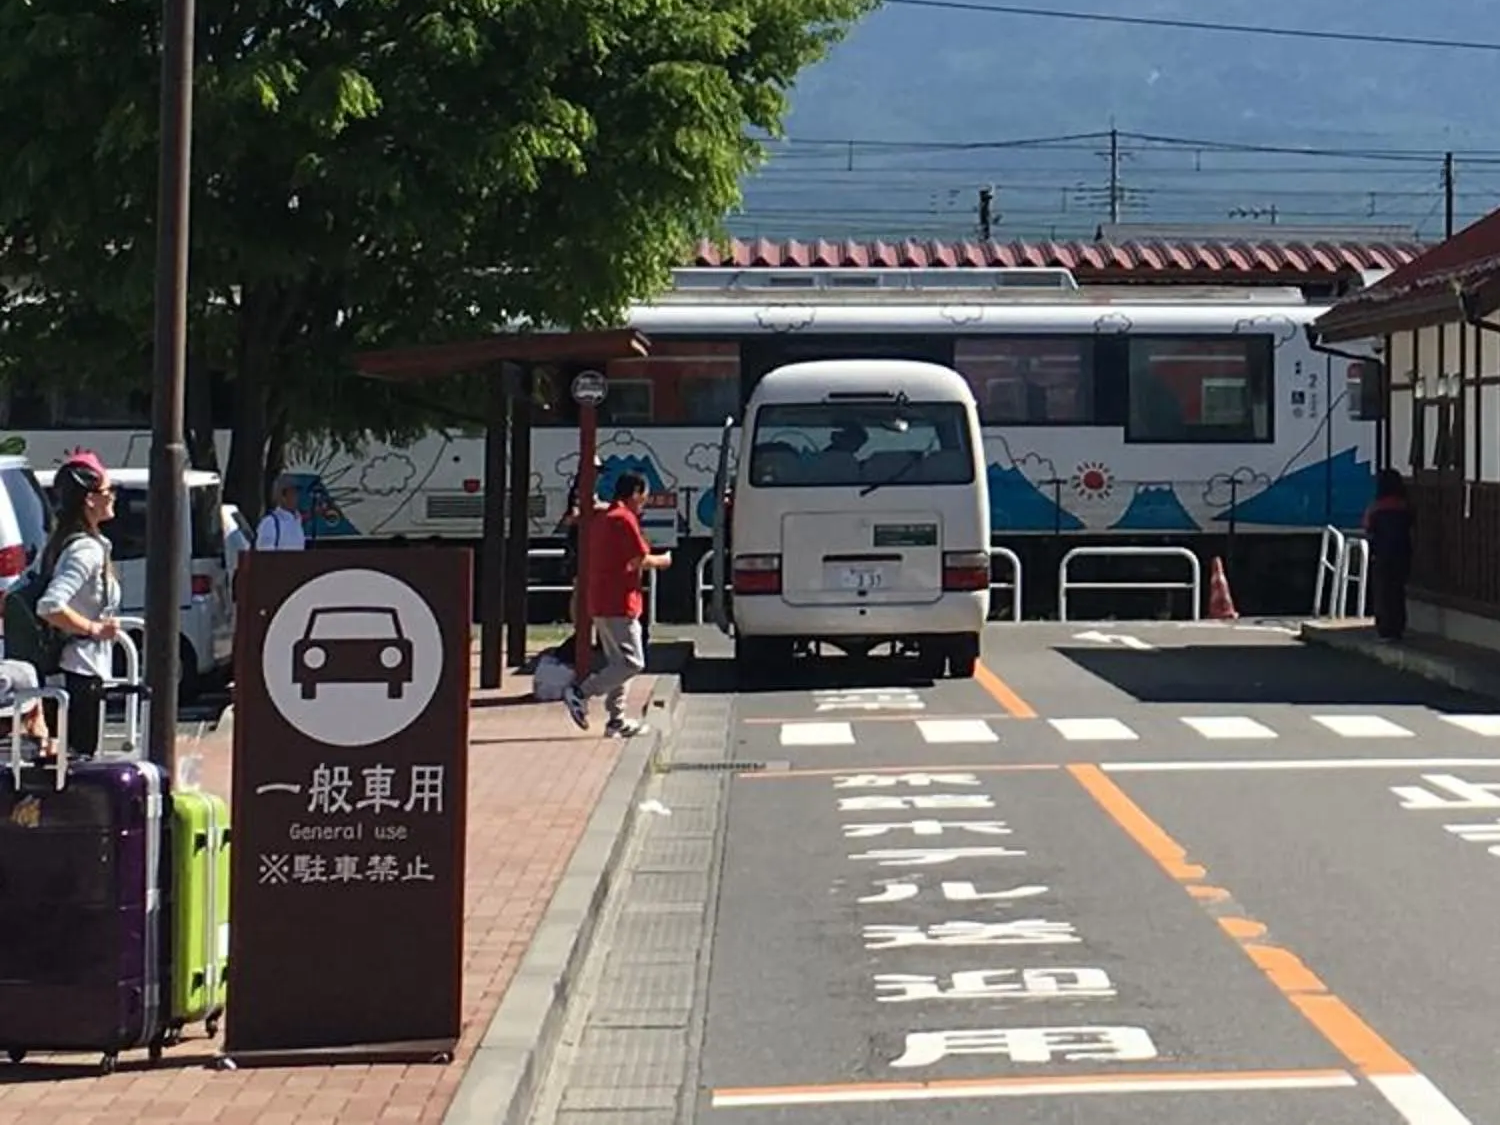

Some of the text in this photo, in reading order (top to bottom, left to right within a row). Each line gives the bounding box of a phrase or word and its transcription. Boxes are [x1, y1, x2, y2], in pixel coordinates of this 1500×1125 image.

[255, 762, 445, 814] 一般車用
[289, 823, 408, 840] General use
